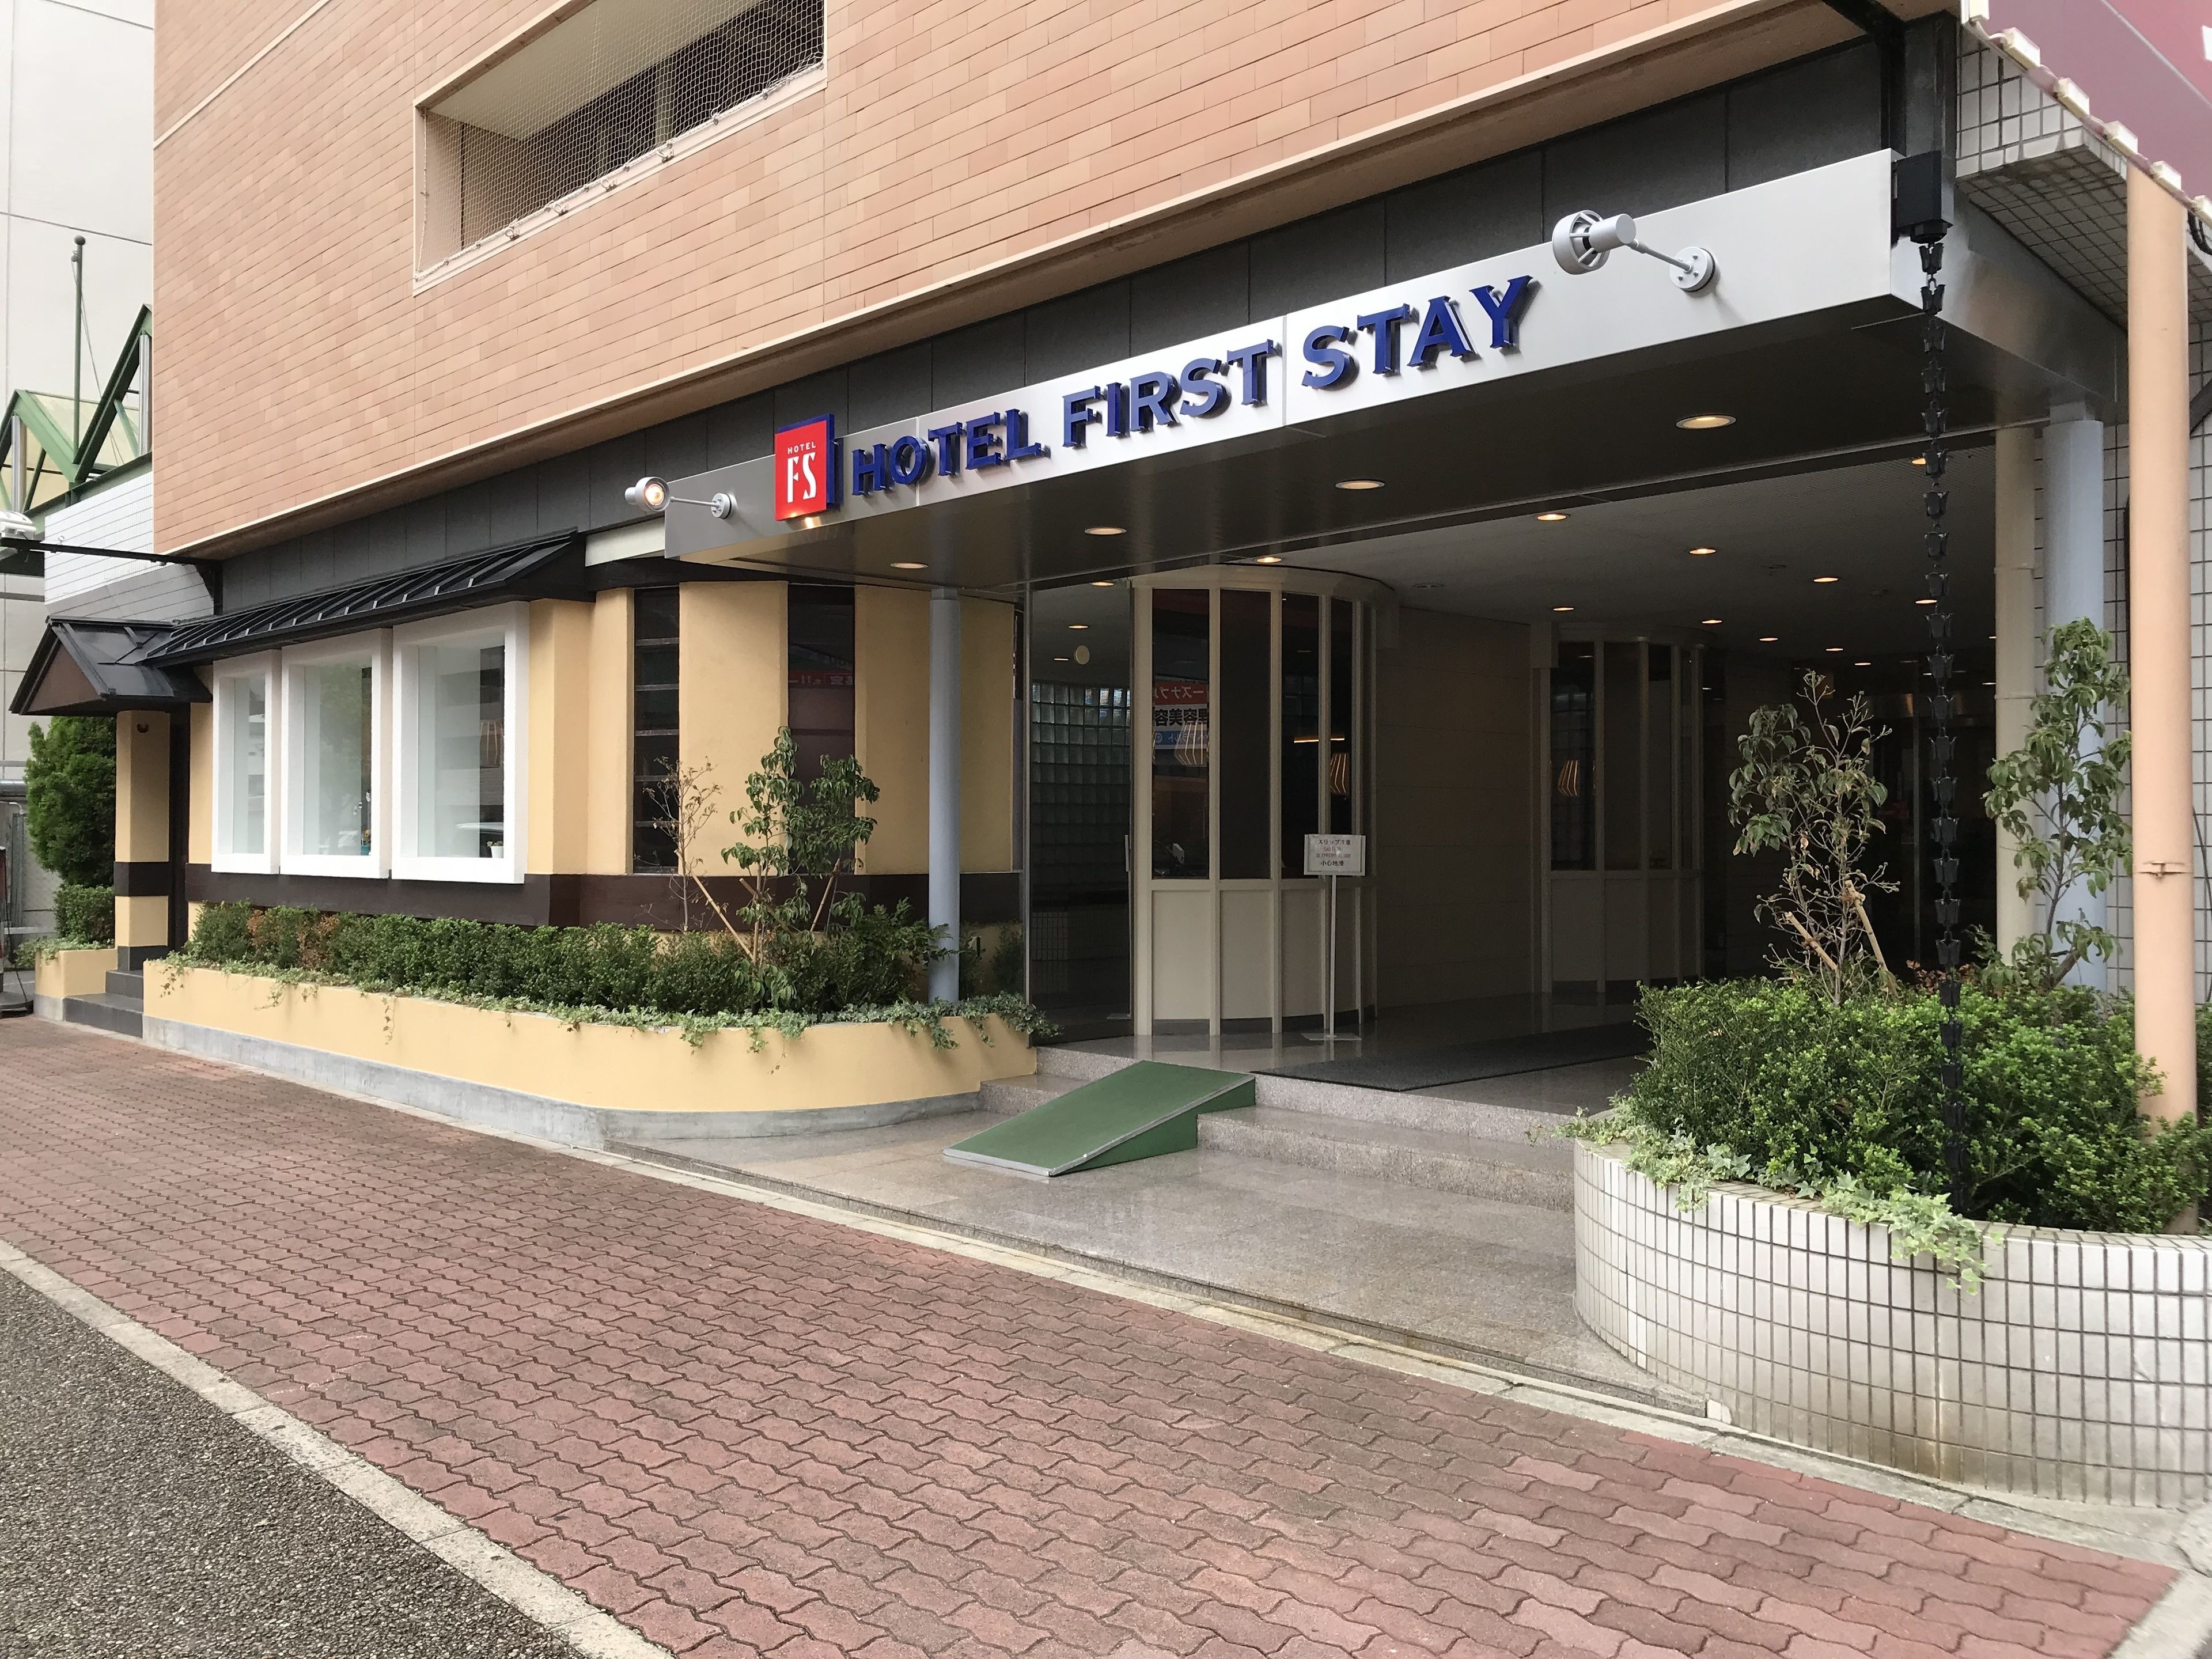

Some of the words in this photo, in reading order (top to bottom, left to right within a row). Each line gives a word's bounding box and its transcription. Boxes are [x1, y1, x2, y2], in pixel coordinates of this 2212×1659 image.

[852, 408, 1050, 495] HOTEL
[1063, 339, 1280, 448] FIRST
[1302, 275, 1532, 388] STAY
[787, 441, 816, 454] HOTEL
[787, 452, 817, 503] FS
